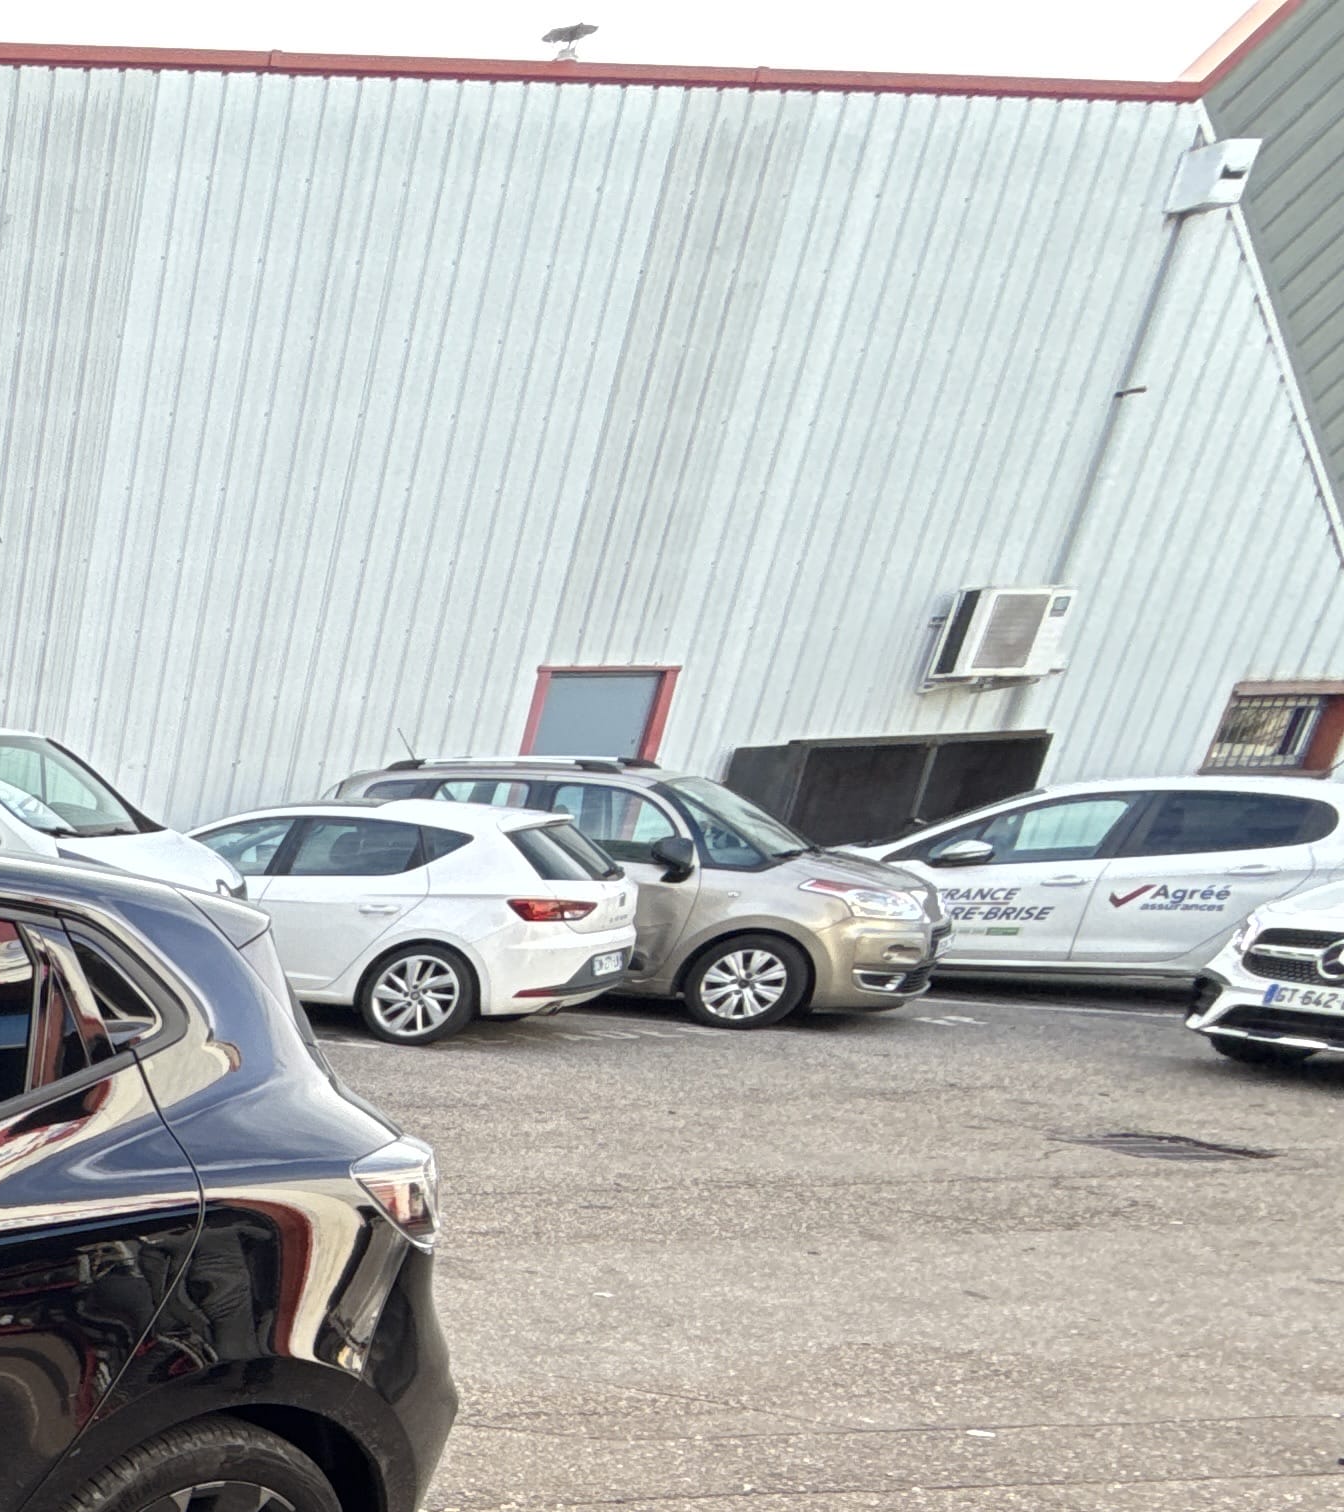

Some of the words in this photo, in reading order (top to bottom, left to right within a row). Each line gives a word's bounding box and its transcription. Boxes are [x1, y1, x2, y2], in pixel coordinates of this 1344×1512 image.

[1150, 884, 1232, 904] Agréé
[949, 905, 1055, 921] RE-BRISE
[1139, 902, 1225, 912] assurances
[1274, 986, 1344, 1011] GT-642-
